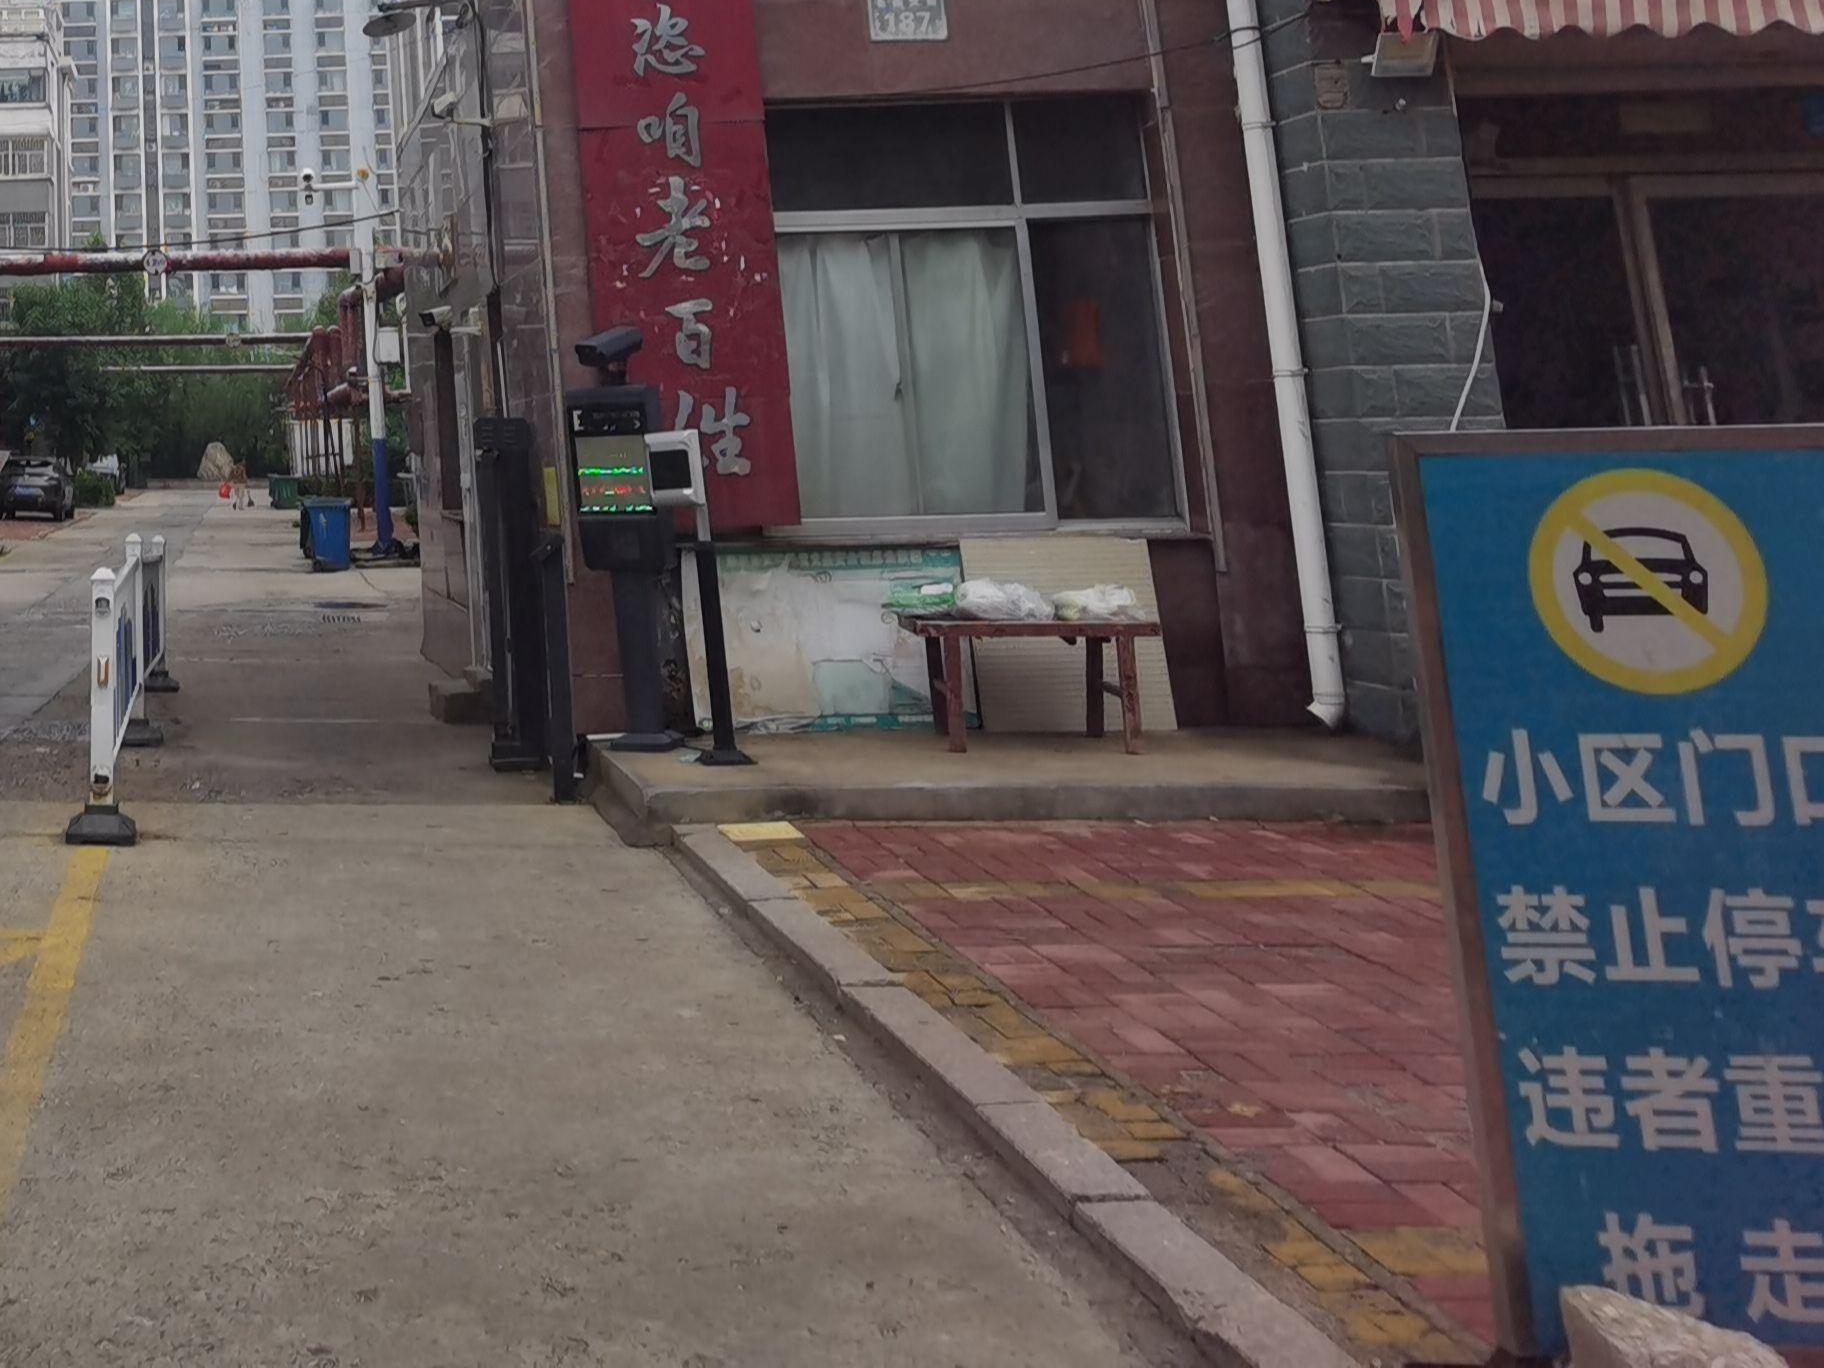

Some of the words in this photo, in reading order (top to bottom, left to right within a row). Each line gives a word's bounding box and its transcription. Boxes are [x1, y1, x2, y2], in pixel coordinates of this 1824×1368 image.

[1496, 886, 1824, 990] 禁止停
[1518, 1046, 1824, 1153] 违者重
